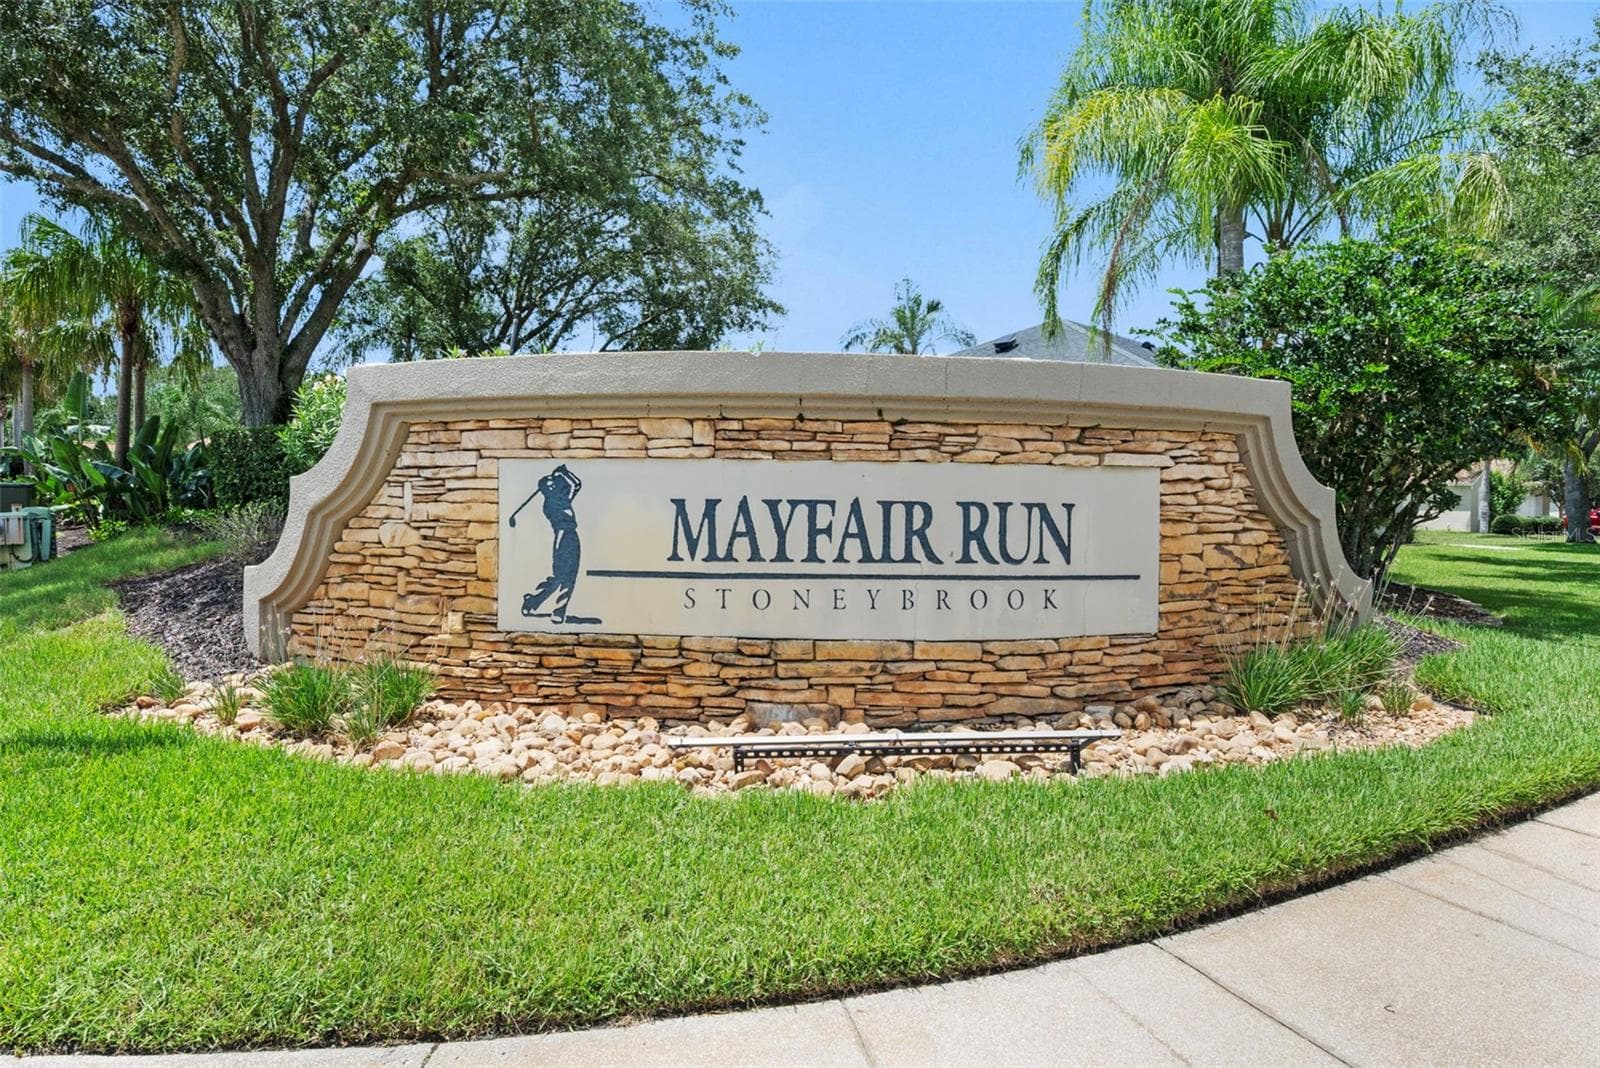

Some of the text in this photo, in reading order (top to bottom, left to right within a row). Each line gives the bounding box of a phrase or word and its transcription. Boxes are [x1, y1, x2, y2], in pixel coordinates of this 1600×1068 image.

[667, 495, 1076, 566] MAYFAIR RUN
[684, 588, 1059, 611] STONEYBROOK
